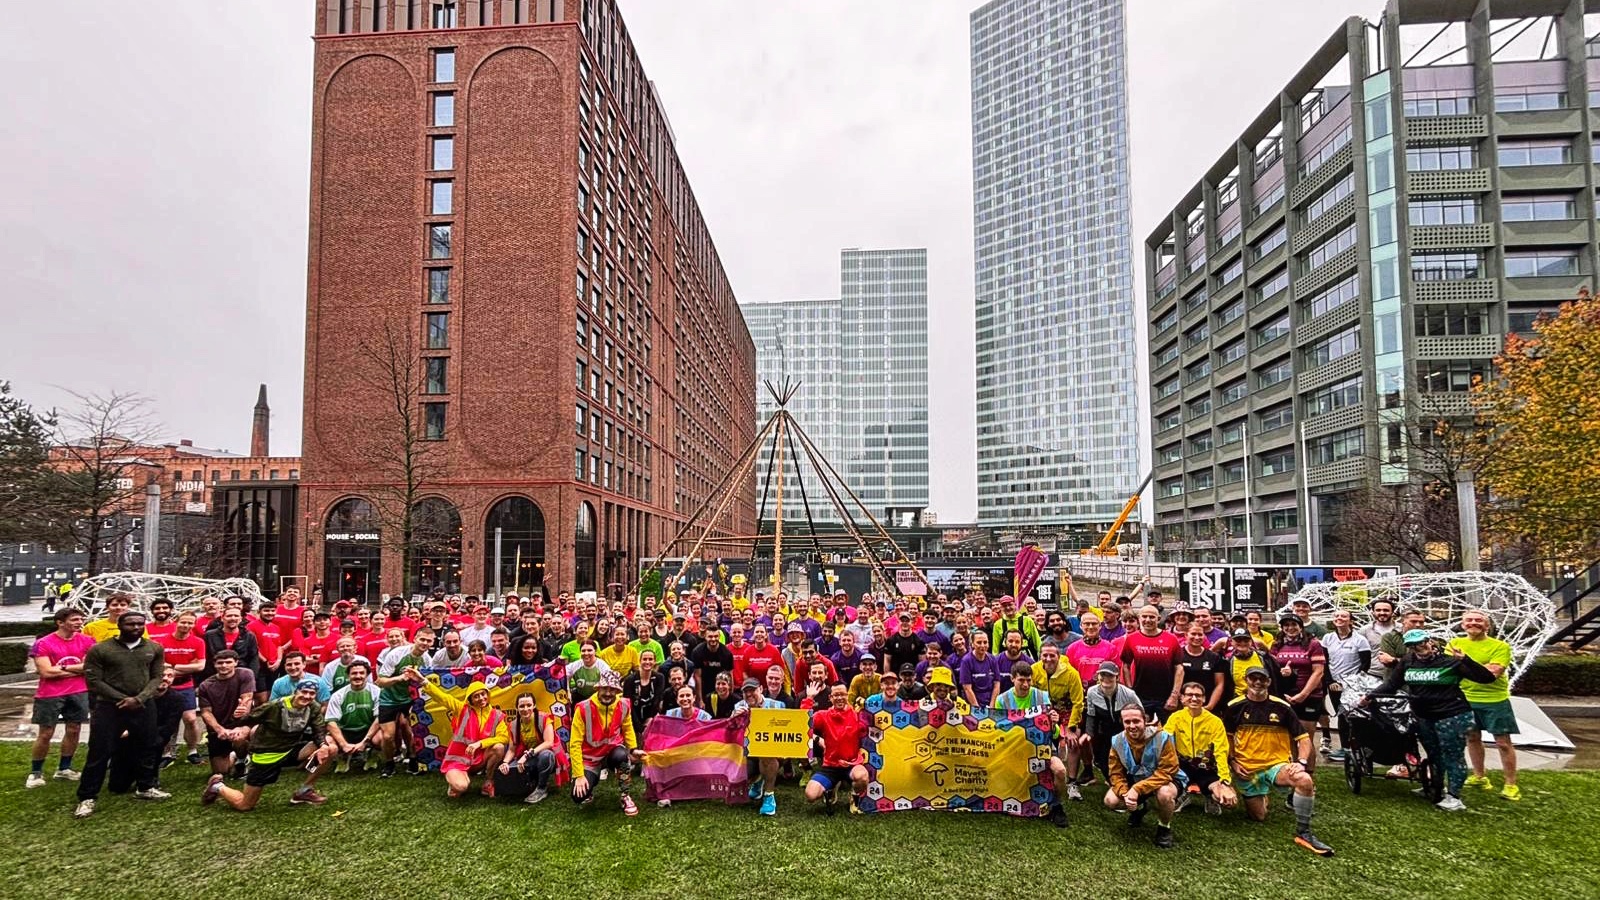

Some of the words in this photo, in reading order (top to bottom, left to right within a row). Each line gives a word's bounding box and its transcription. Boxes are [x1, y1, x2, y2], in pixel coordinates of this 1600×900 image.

[175, 481, 205, 491] INDIA
[487, 676, 496, 684] 24
[955, 703, 967, 711] 24
[755, 732, 769, 742] 35
[774, 733, 803, 743] MINS
[954, 776, 988, 786] Charity
